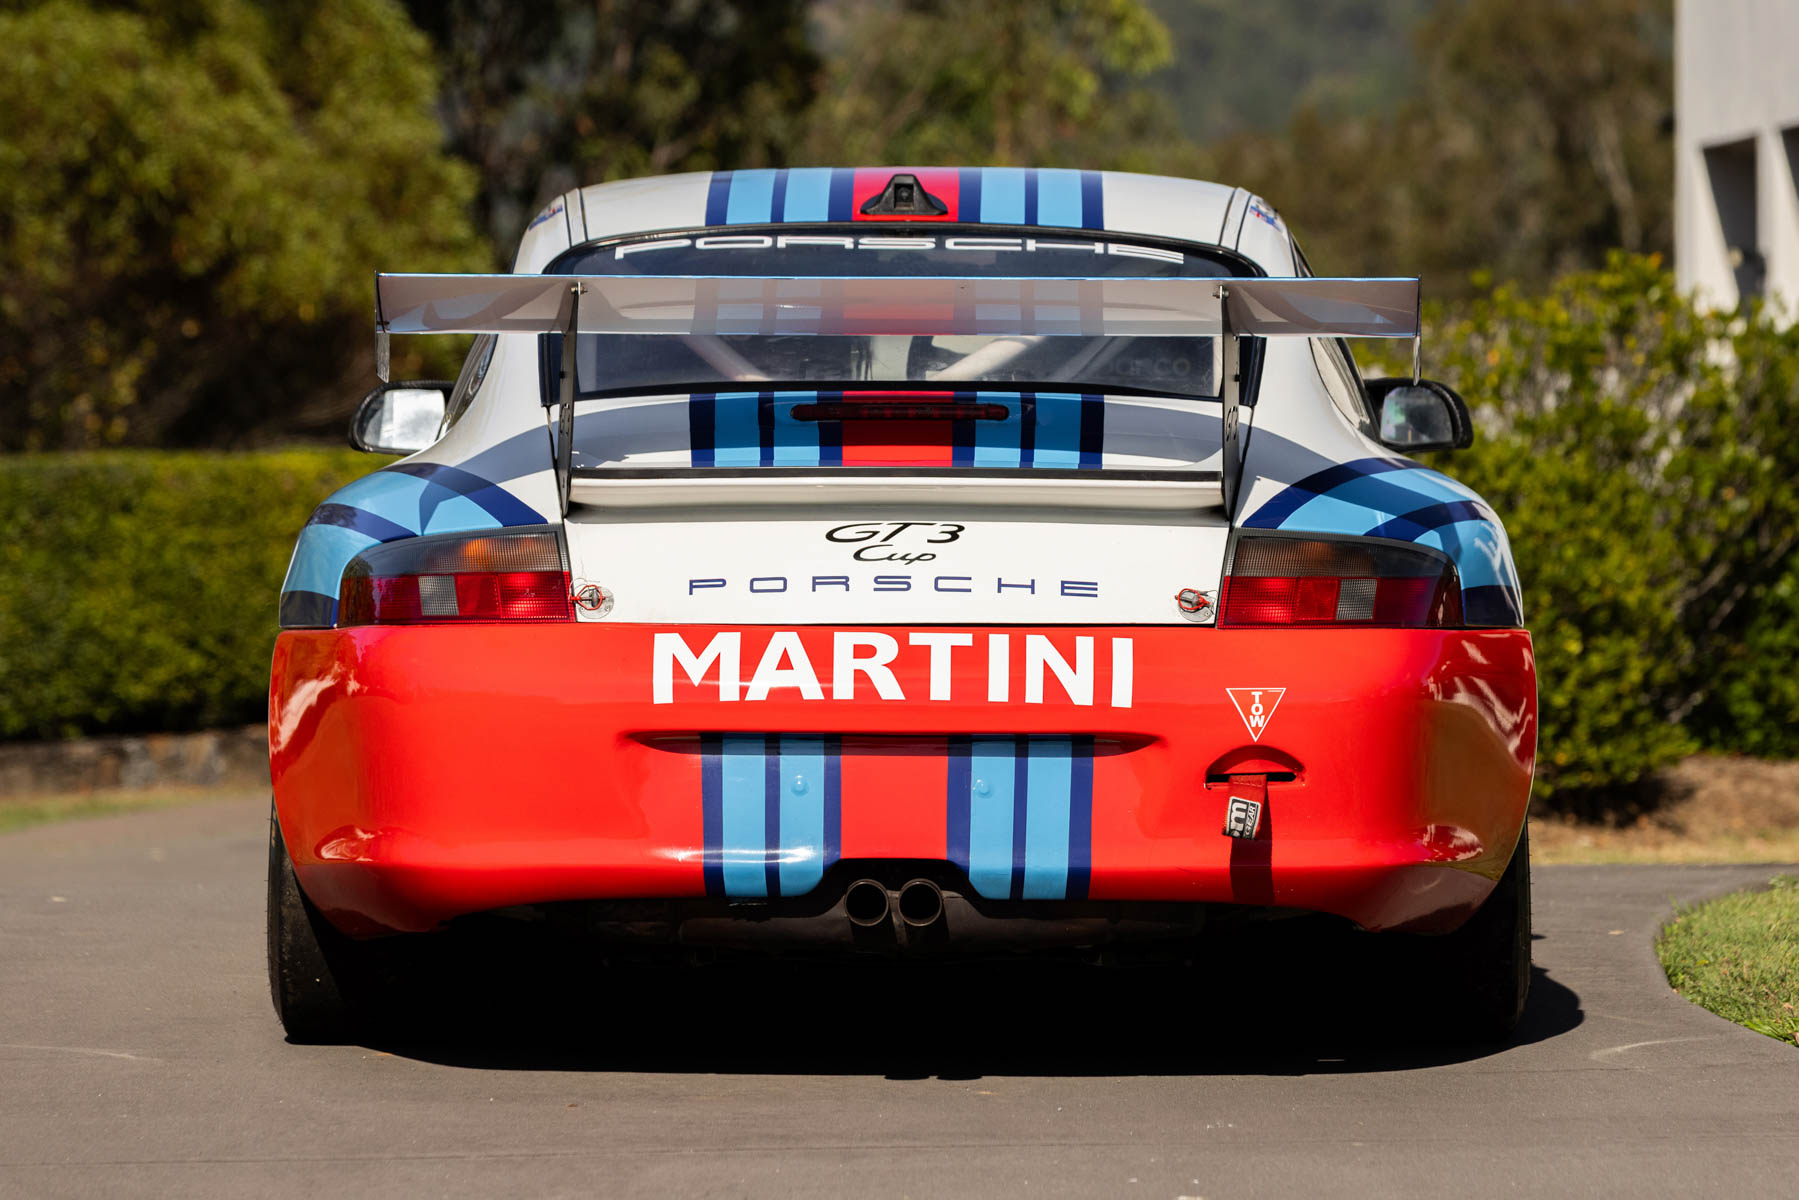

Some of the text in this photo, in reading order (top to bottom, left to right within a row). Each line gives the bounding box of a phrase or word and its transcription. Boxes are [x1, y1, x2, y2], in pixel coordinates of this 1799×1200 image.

[614, 235, 1185, 265] PORSCHE
[852, 544, 937, 566] Cup
[688, 575, 1099, 598] PORSCHE
[652, 631, 1134, 709] MARTINI
[1249, 691, 1265, 728] TOW
